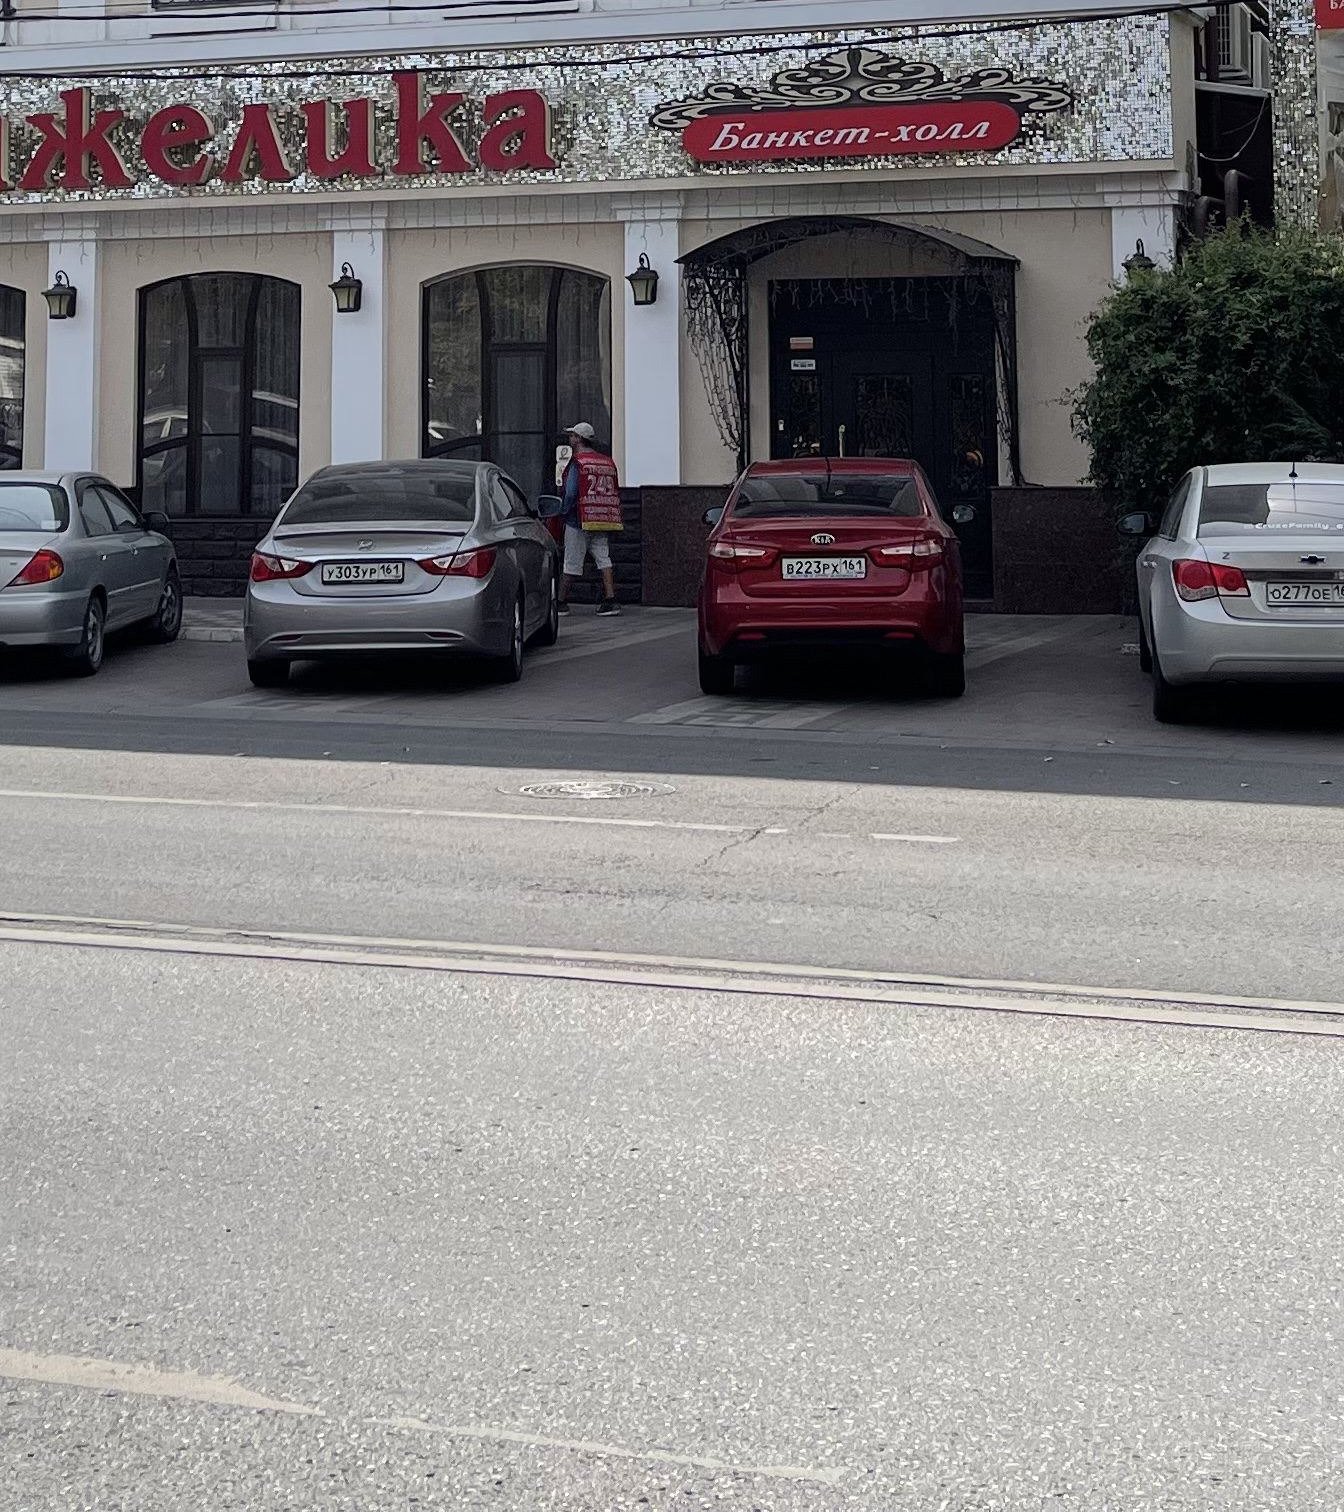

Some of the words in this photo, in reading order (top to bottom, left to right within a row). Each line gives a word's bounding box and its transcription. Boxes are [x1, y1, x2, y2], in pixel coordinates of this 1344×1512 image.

[708, 120, 992, 152] Банкет-холл
[379, 564, 399, 575] 161
[786, 560, 839, 575] В223РХ
[842, 559, 863, 570] 161
